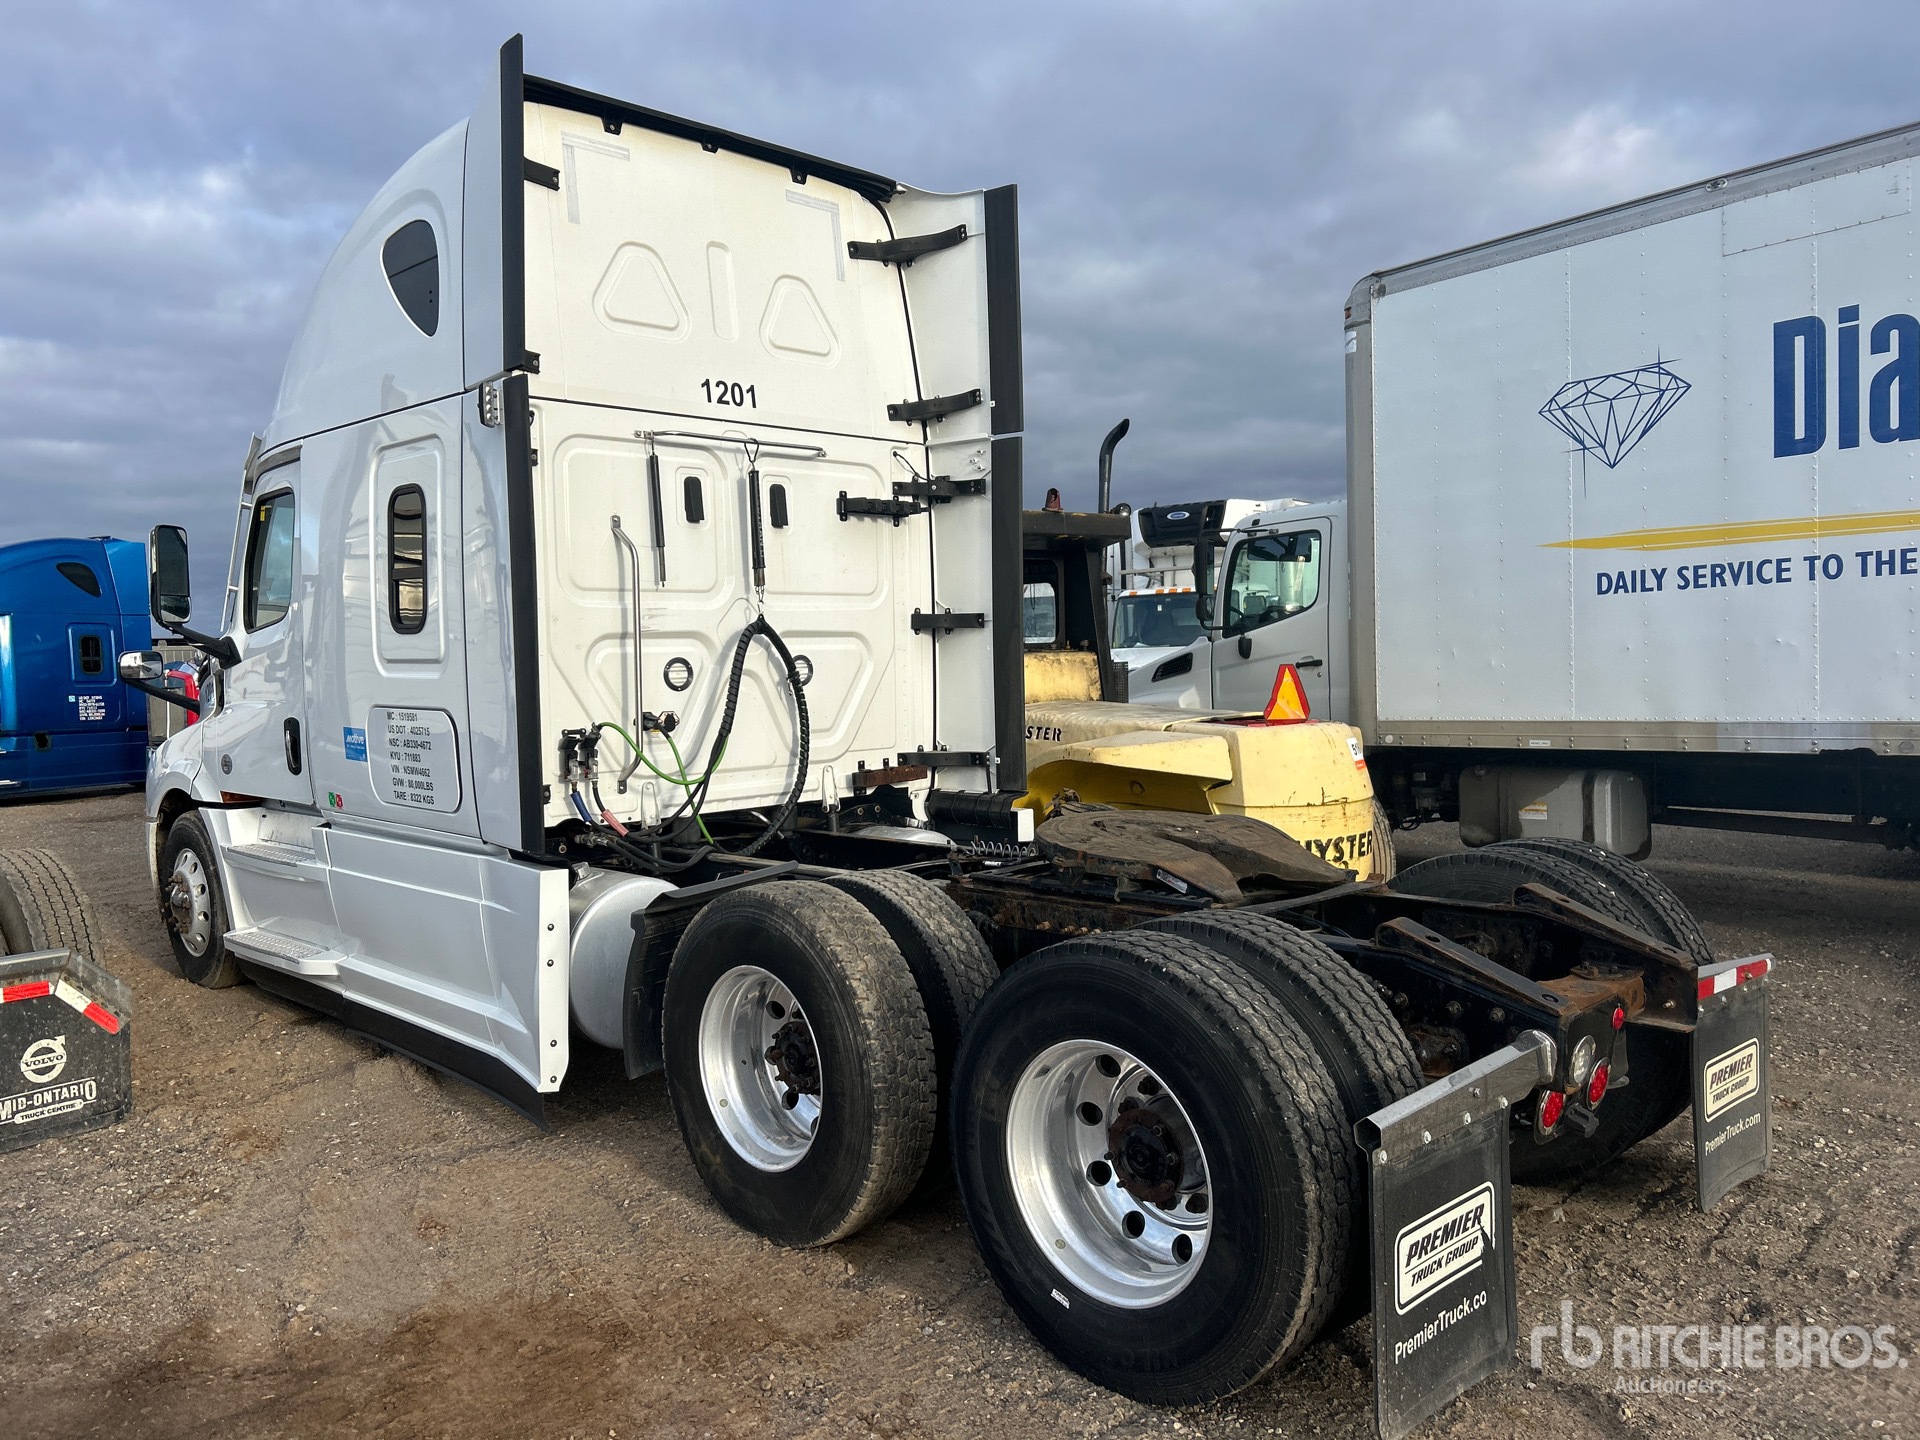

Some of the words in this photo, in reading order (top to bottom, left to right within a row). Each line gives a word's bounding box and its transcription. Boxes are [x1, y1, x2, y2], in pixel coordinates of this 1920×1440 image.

[700, 378, 757, 409] 1201
[1772, 303, 1920, 459] Dia
[1596, 567, 1668, 596] DAILY
[1677, 557, 1792, 591] SERVICE
[1803, 552, 1844, 581] TO
[1855, 546, 1918, 578] THE
[387, 711, 395, 721] MC
[388, 724, 395, 734] US
[396, 725, 406, 735] DOT
[389, 738, 400, 747] NSC
[390, 751, 401, 761] KYU
[391, 764, 400, 774] VIN
[392, 777, 405, 788] GVW
[393, 790, 407, 801] TARE
[423, 794, 435, 805] KGS
[24, 1054, 64, 1068] VOLVO
[1710, 1053, 1753, 1090] PREMIER
[0, 1080, 97, 1121] MID-ONTARIO
[1712, 1088, 1730, 1104] TRUCK
[1730, 1076, 1749, 1093] GROUP
[20, 1109, 47, 1121] TRUCK
[1704, 1112, 1761, 1157] PremierTruck.com
[1405, 1203, 1485, 1268] PREMIER
[1410, 1255, 1445, 1288] TRUCK
[1445, 1235, 1479, 1269] GROUP
[1394, 1290, 1487, 1365] PremierTruck.co
